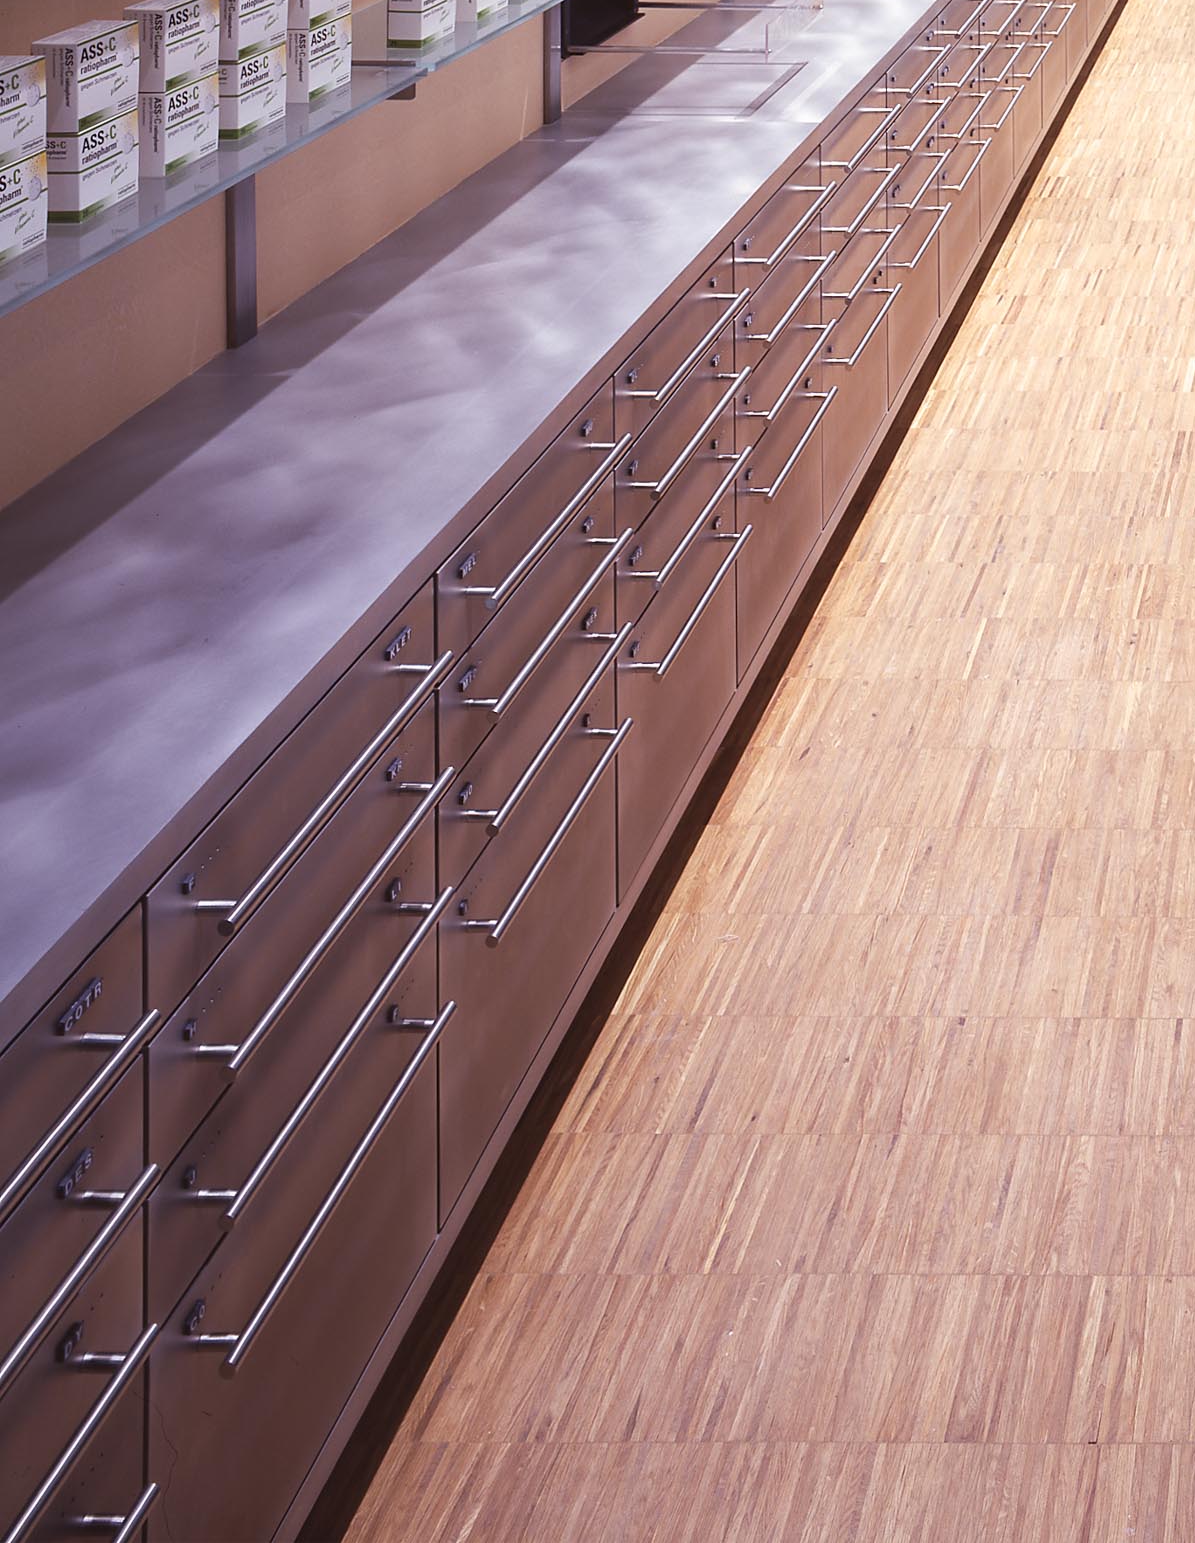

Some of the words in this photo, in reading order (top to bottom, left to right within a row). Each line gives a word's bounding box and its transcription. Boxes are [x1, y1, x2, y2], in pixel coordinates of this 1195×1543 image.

[168, 4, 200, 28] ASS+C
[168, 22, 200, 40] ratiopharm
[311, 24, 336, 47] ASS+C
[80, 36, 117, 64] ASS+C
[310, 40, 336, 56] ratiopharm
[80, 53, 117, 76] ratiopharm
[240, 56, 269, 80] ASS+C
[240, 70, 269, 90] ratiopharm
[168, 86, 199, 112] ASS+C
[168, 103, 199, 124] ratiopharm
[82, 124, 117, 154] ASS+C
[82, 140, 118, 166] ratiopharm
